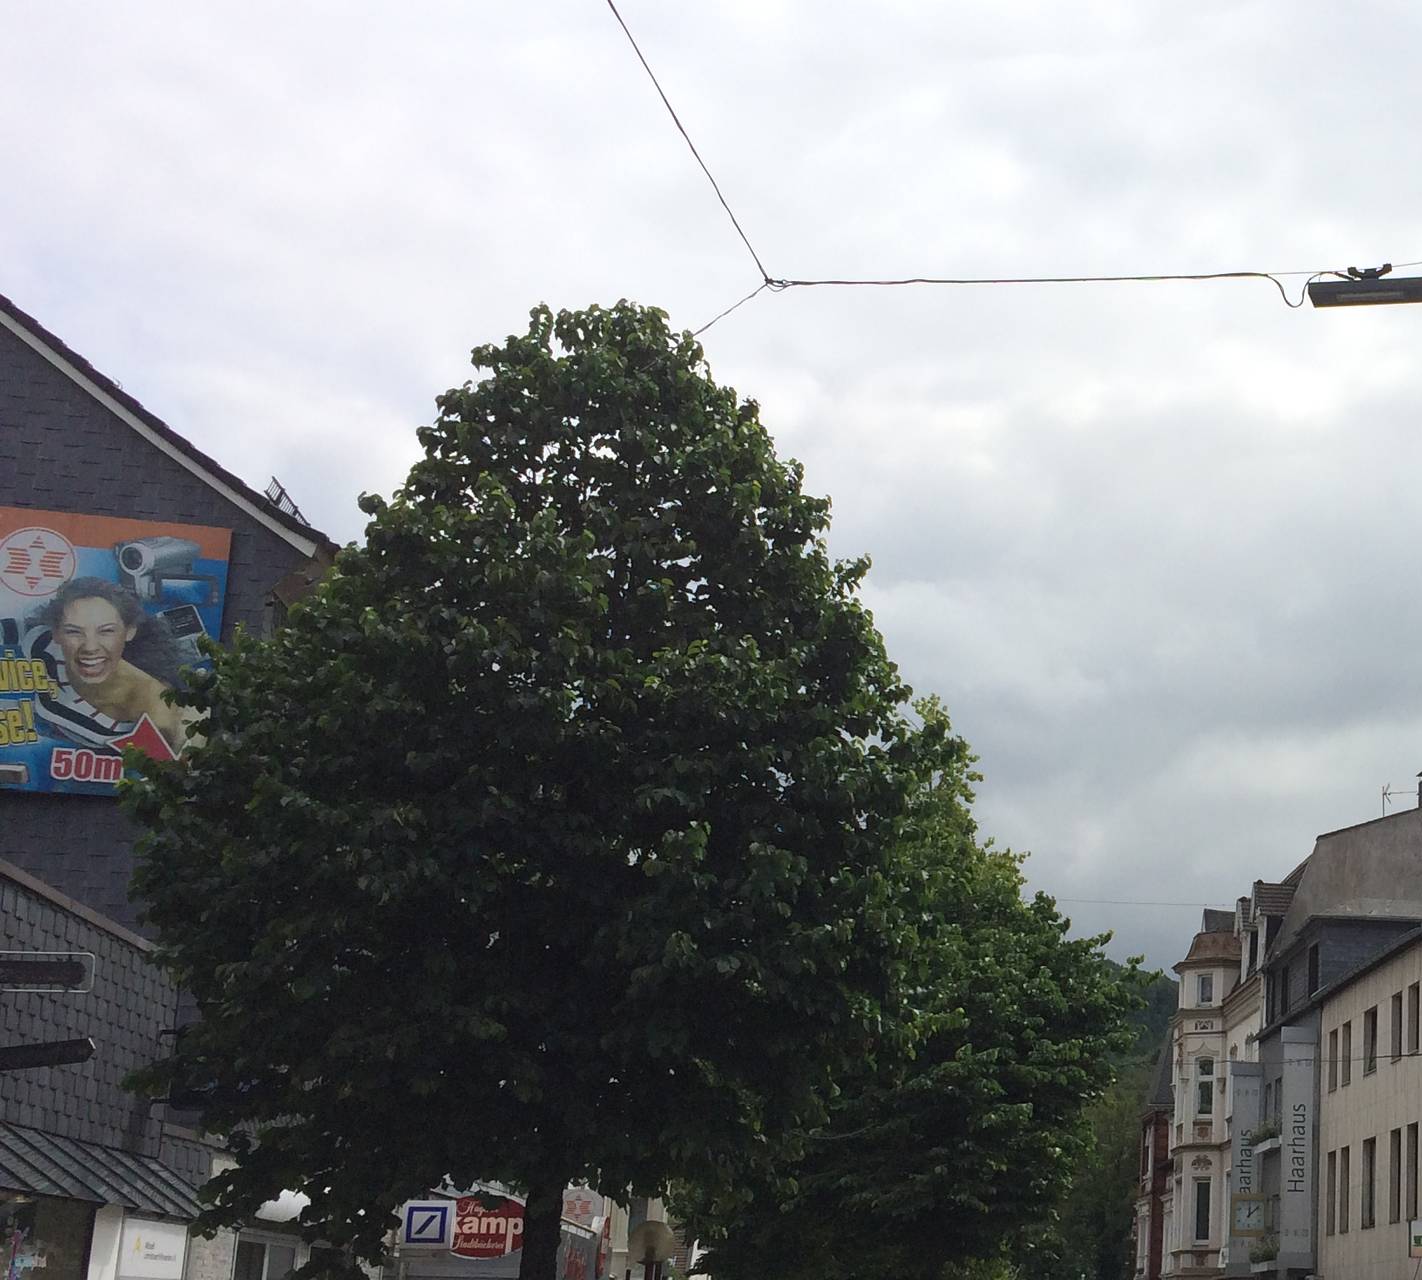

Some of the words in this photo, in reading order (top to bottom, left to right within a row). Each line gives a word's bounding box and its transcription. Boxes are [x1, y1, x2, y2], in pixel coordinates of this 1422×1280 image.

[51, 747, 123, 782] 50m
[1235, 1129, 1252, 1194] aarhaus
[1286, 1103, 1307, 1193] Haarhaus
